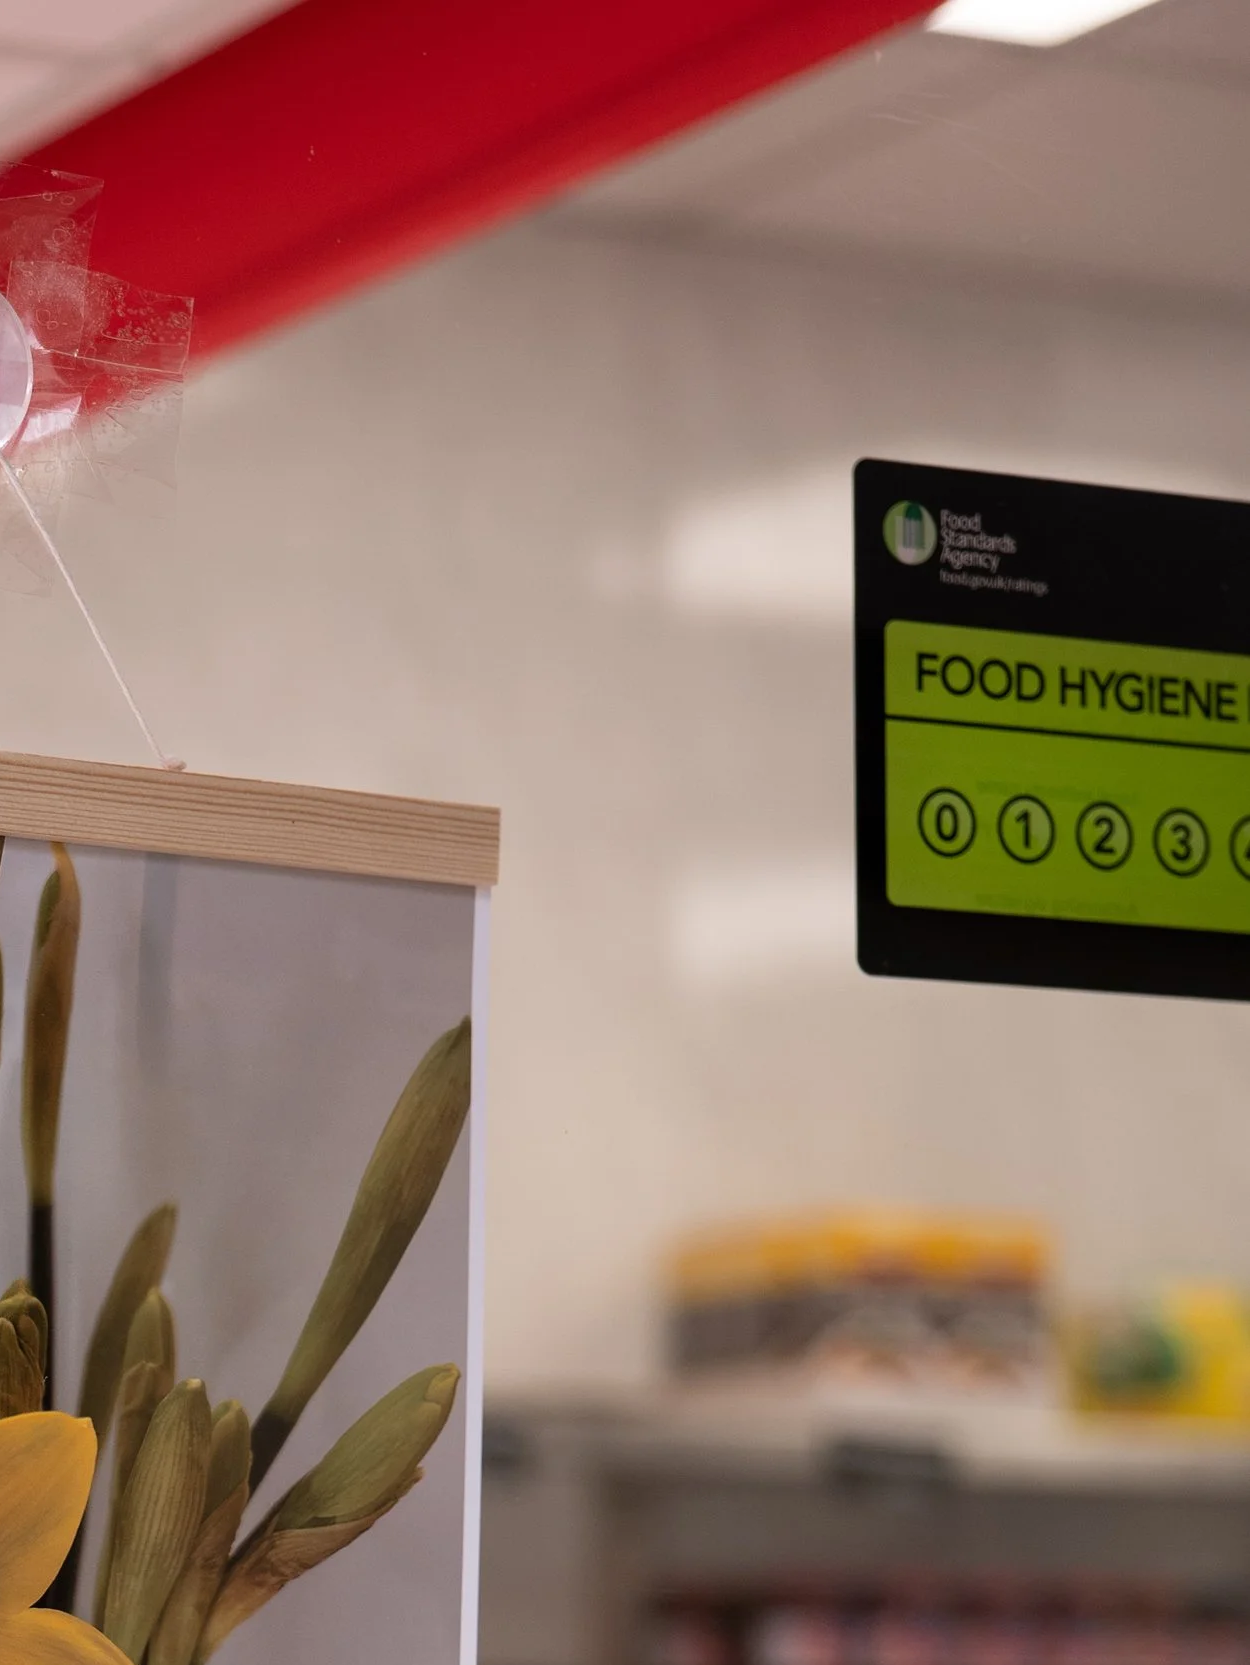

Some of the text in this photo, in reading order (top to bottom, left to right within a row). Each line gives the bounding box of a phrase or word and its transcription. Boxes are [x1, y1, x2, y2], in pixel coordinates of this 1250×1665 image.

[940, 508, 982, 532] Food
[940, 526, 1018, 554] Standards
[939, 546, 1001, 573] Agency
[916, 651, 1045, 702] FOOD
[1058, 665, 1239, 724] HYGIENE
[934, 803, 959, 842] 0
[1092, 815, 1116, 855] 2
[1169, 823, 1193, 862] 3
